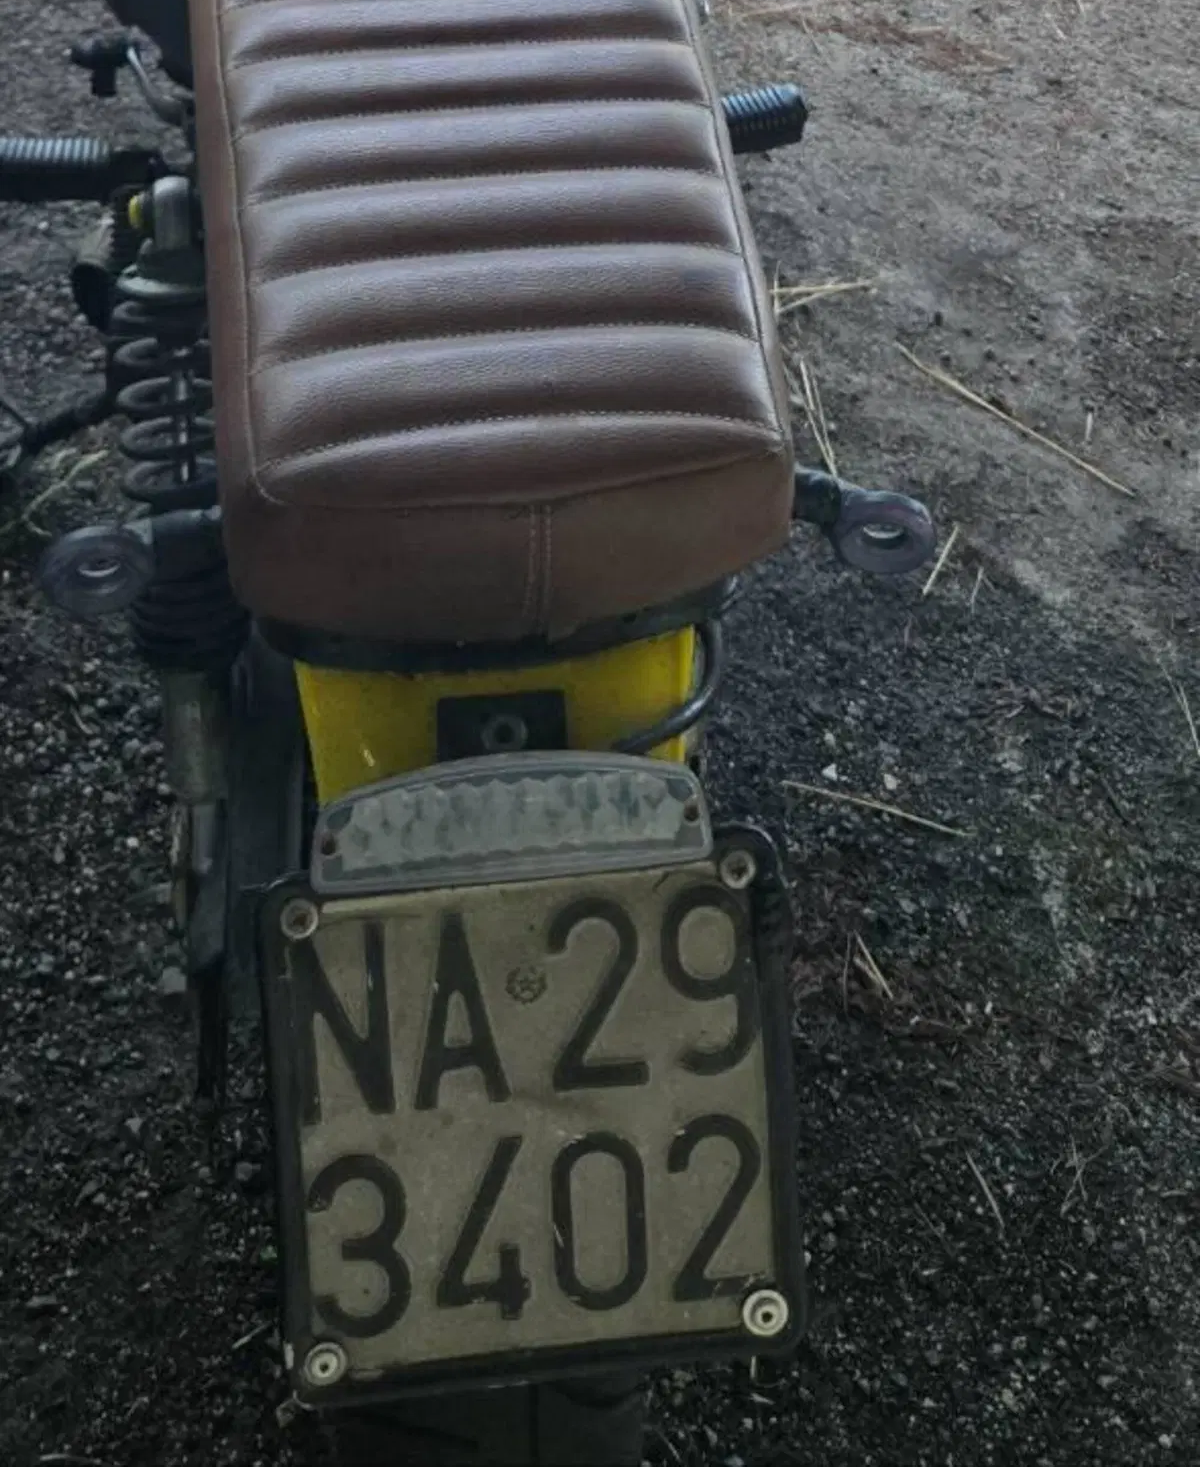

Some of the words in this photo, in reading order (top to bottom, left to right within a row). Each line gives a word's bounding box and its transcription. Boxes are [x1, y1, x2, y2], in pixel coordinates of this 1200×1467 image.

[299, 912, 511, 1124] NA
[545, 883, 759, 1091] 29
[305, 1114, 762, 1336] 3402
